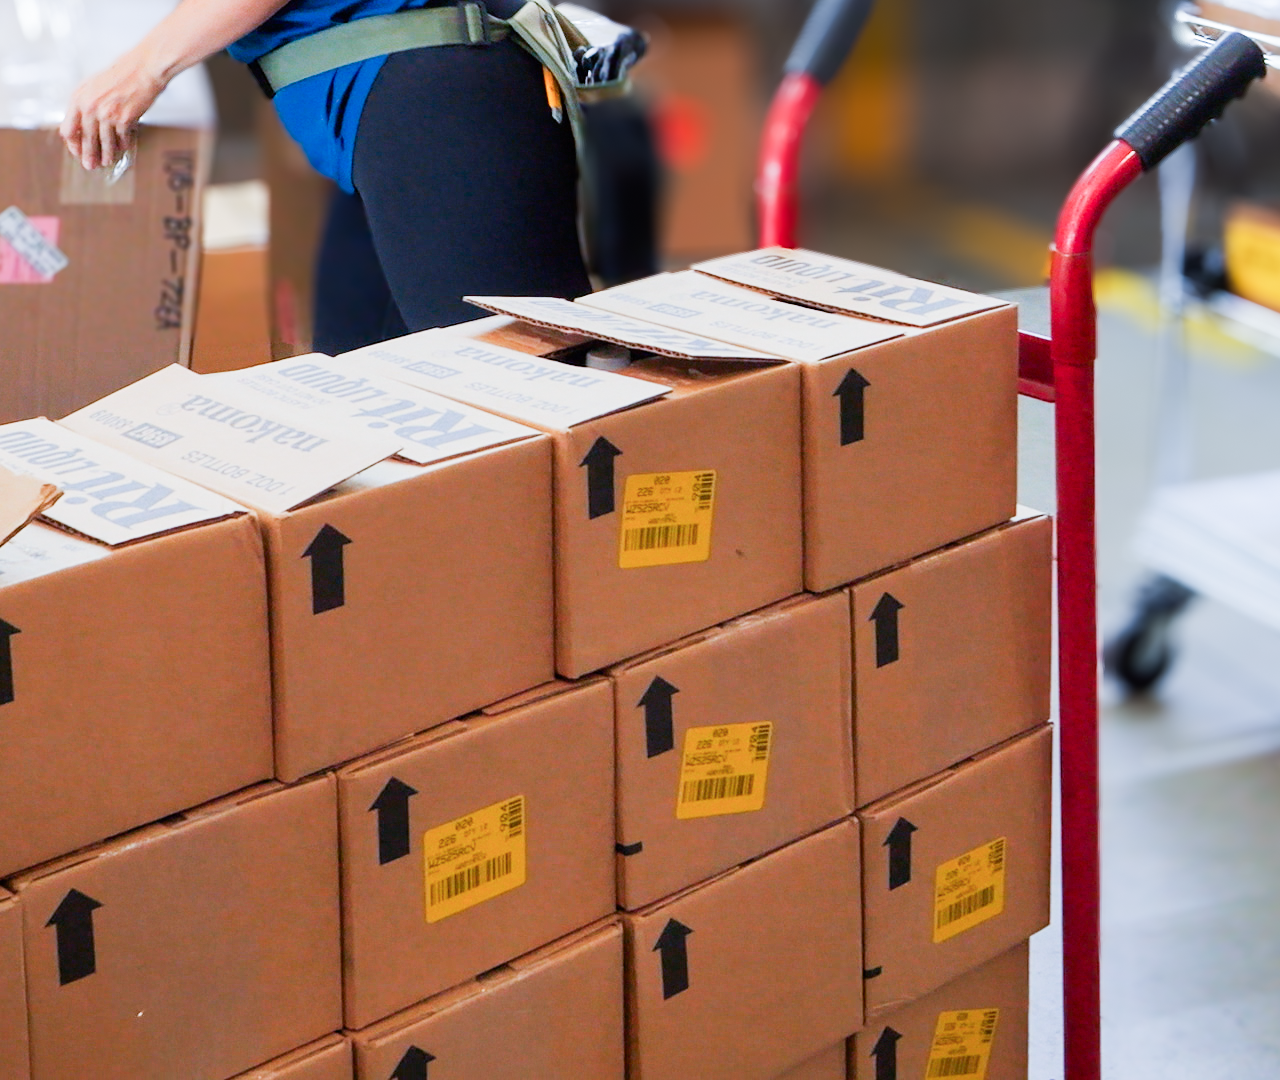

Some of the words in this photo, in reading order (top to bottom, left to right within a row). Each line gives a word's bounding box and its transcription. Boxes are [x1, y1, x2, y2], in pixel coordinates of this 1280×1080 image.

[750, 254, 857, 283] LIQUID
[690, 290, 839, 329] nakoma
[833, 278, 976, 316] Rit
[277, 363, 388, 404] LIQUID
[454, 344, 605, 389] nakoma
[180, 393, 329, 454] nakoma
[351, 398, 503, 450] Rit
[181, 449, 250, 480] BOTTLES
[60, 469, 207, 529] Rit
